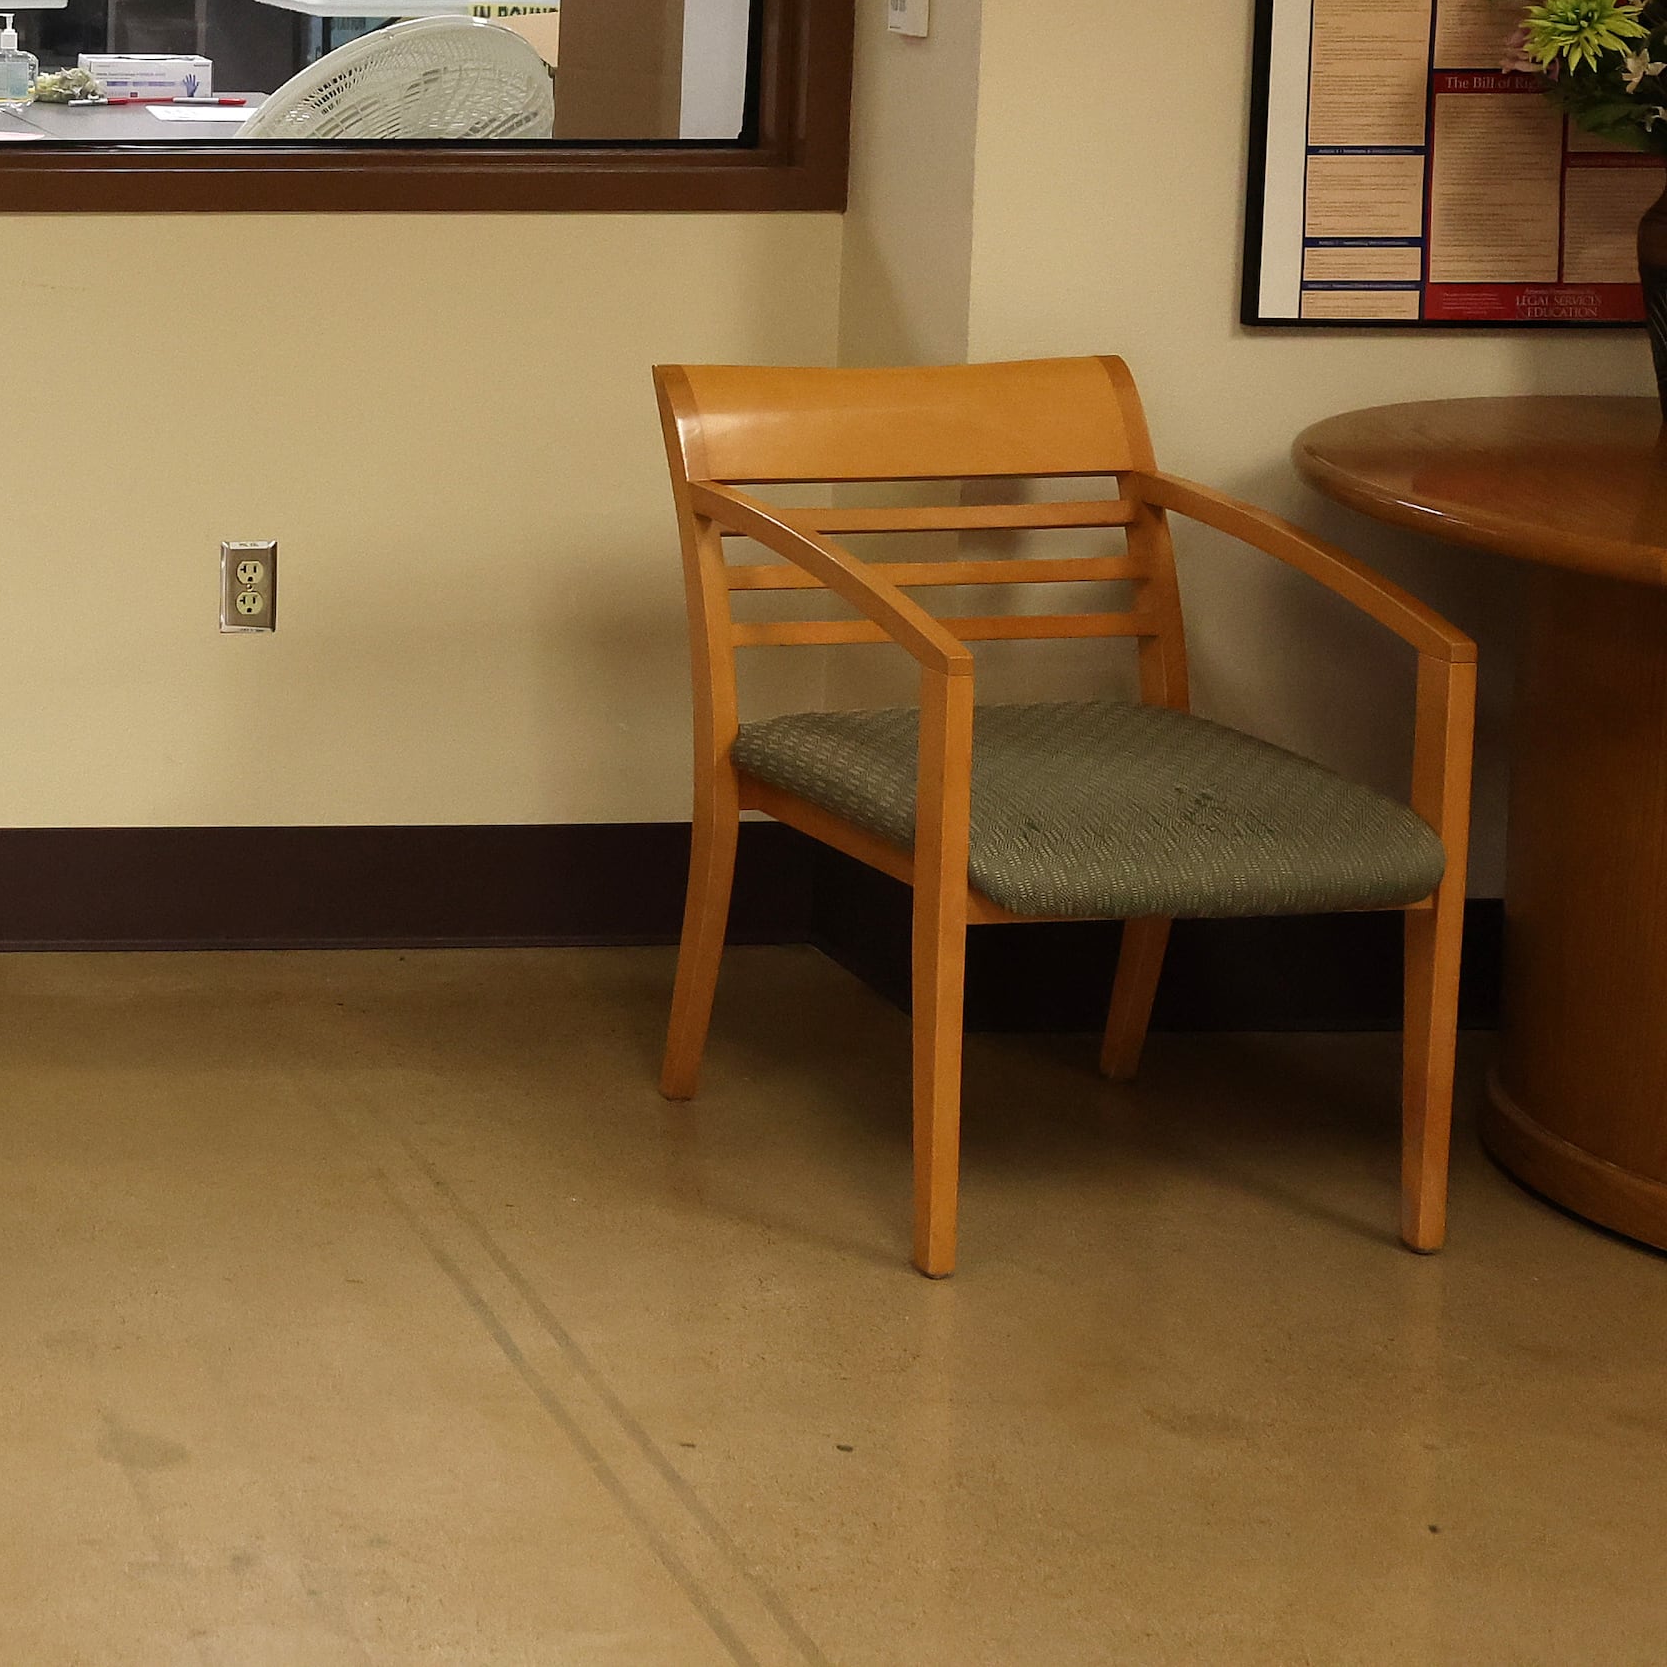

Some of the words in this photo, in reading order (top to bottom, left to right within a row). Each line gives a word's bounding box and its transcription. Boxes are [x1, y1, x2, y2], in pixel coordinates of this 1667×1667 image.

[1447, 77, 1468, 89] The
[1473, 77, 1494, 89] Bill
[1498, 77, 1511, 89] of
[1527, 307, 1598, 318] EDUCATION
